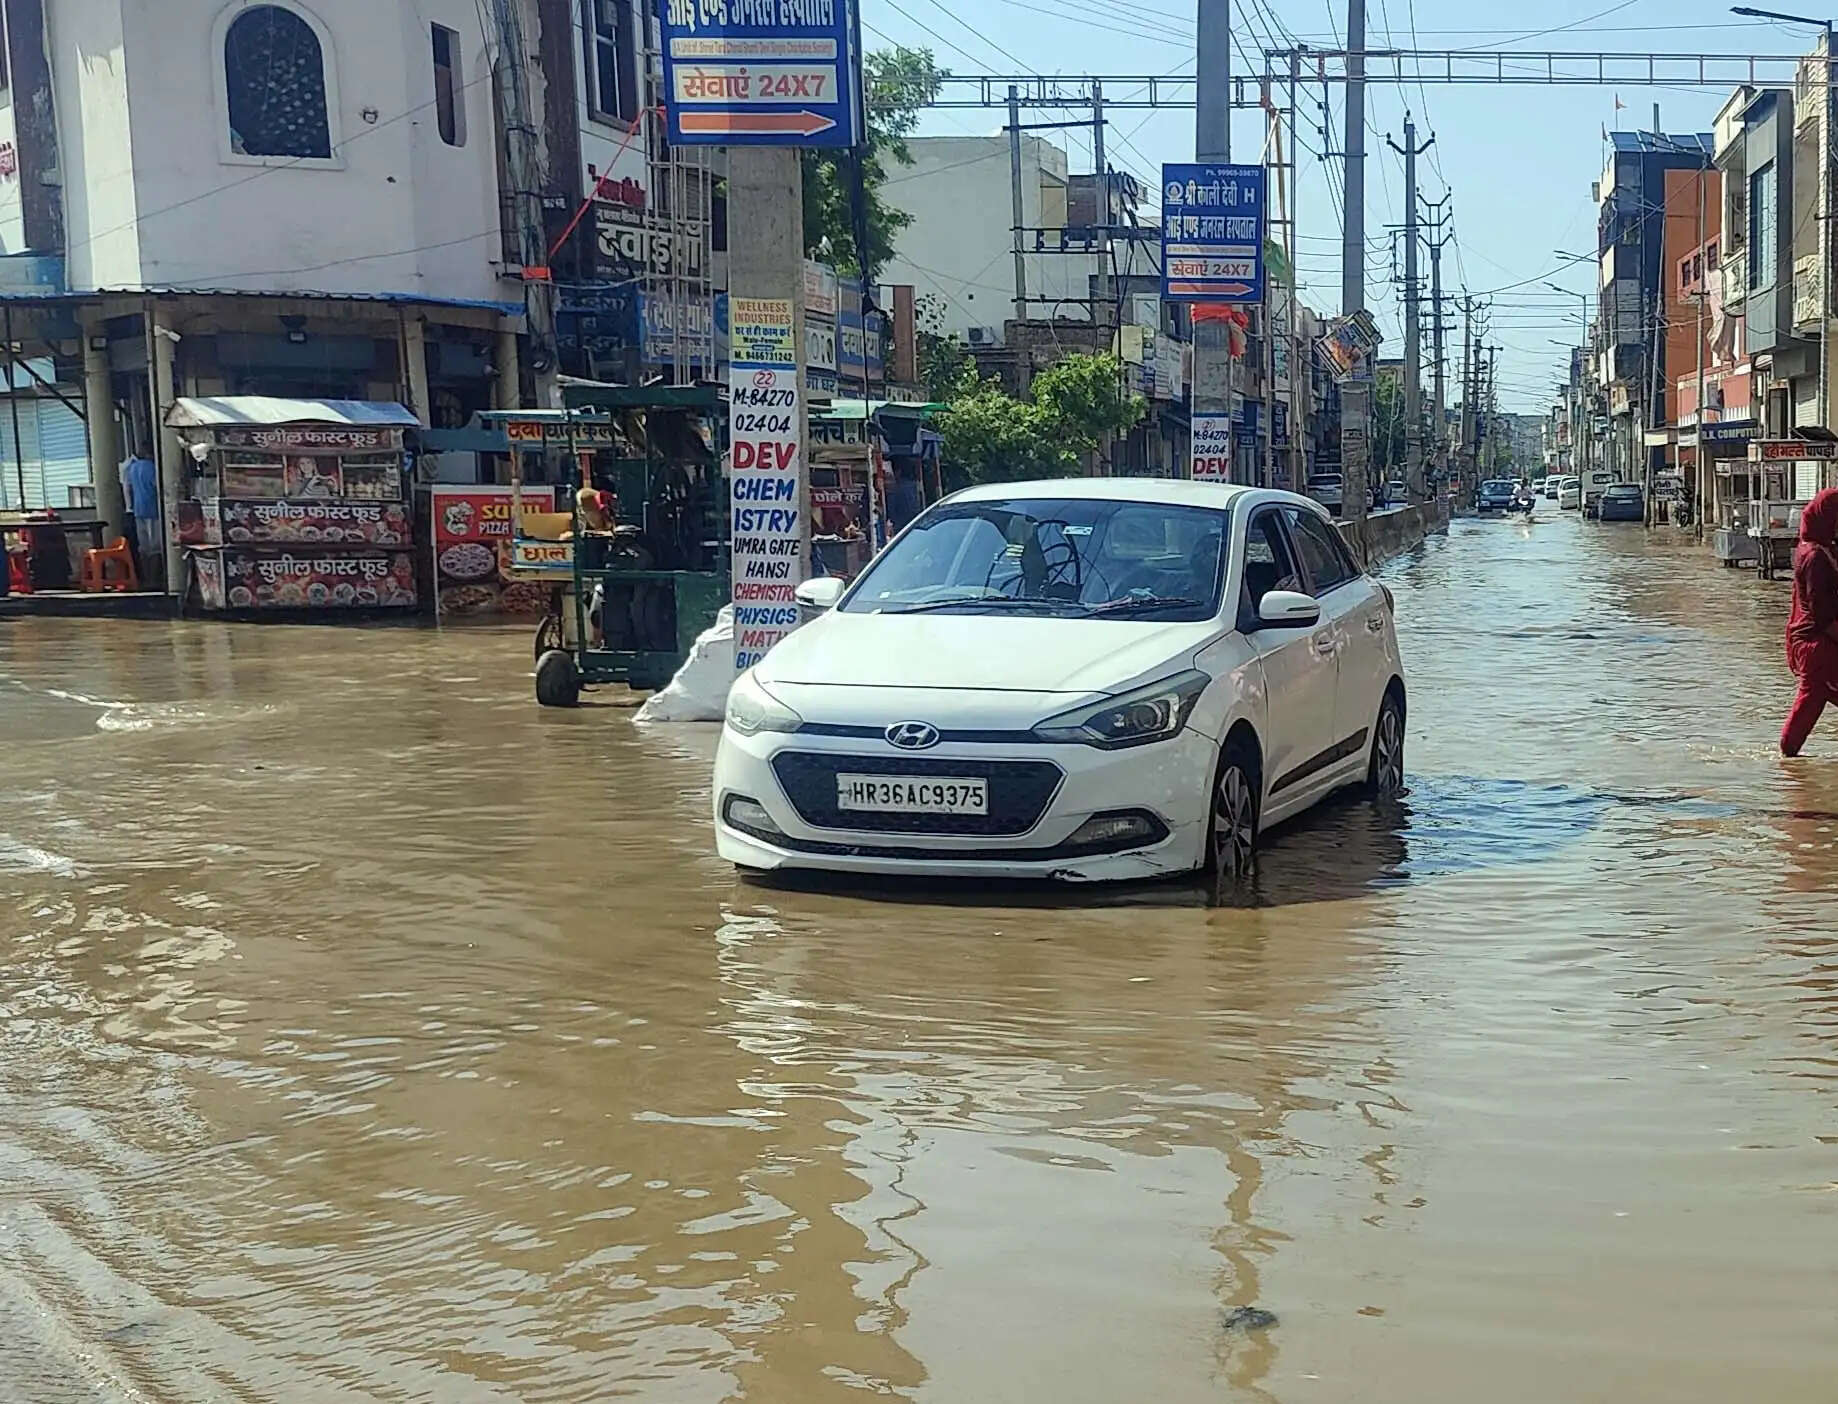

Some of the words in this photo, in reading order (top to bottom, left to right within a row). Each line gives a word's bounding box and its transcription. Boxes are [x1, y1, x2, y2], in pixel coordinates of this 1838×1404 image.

[682, 67, 751, 99] सेवाएं
[758, 74, 826, 97] 24X7
[1185, 180, 1197, 206] श्री
[1197, 180, 1221, 206] काली
[1222, 179, 1238, 206] देवी
[1244, 187, 1255, 203] H
[1171, 260, 1209, 276] सेवाएं
[1213, 263, 1250, 276] 24X7
[737, 301, 788, 313] WELLNESS
[734, 312, 792, 324] INDUSTRIES
[756, 372, 773, 385] 22
[735, 414, 791, 433] 02404
[251, 427, 302, 448] सुनील
[304, 430, 349, 445] फास्ट
[350, 430, 379, 448] फूड
[733, 440, 797, 470] DEV
[1193, 444, 1226, 454] 02404
[1193, 457, 1228, 475] DEV
[733, 478, 795, 501] CHEM
[254, 500, 305, 524] सुनील
[351, 504, 382, 524] फूड
[734, 508, 798, 533] ISTRY
[478, 521, 510, 535] PIZZA
[734, 537, 766, 556] UMRA
[769, 539, 800, 556] GATE
[257, 554, 311, 583] सुनील
[314, 558, 359, 577] फास्ट
[359, 559, 389, 582] फूड
[745, 561, 790, 579] HANSI
[735, 606, 798, 625] PHYSICS
[853, 782, 983, 807] HR36AC9375
